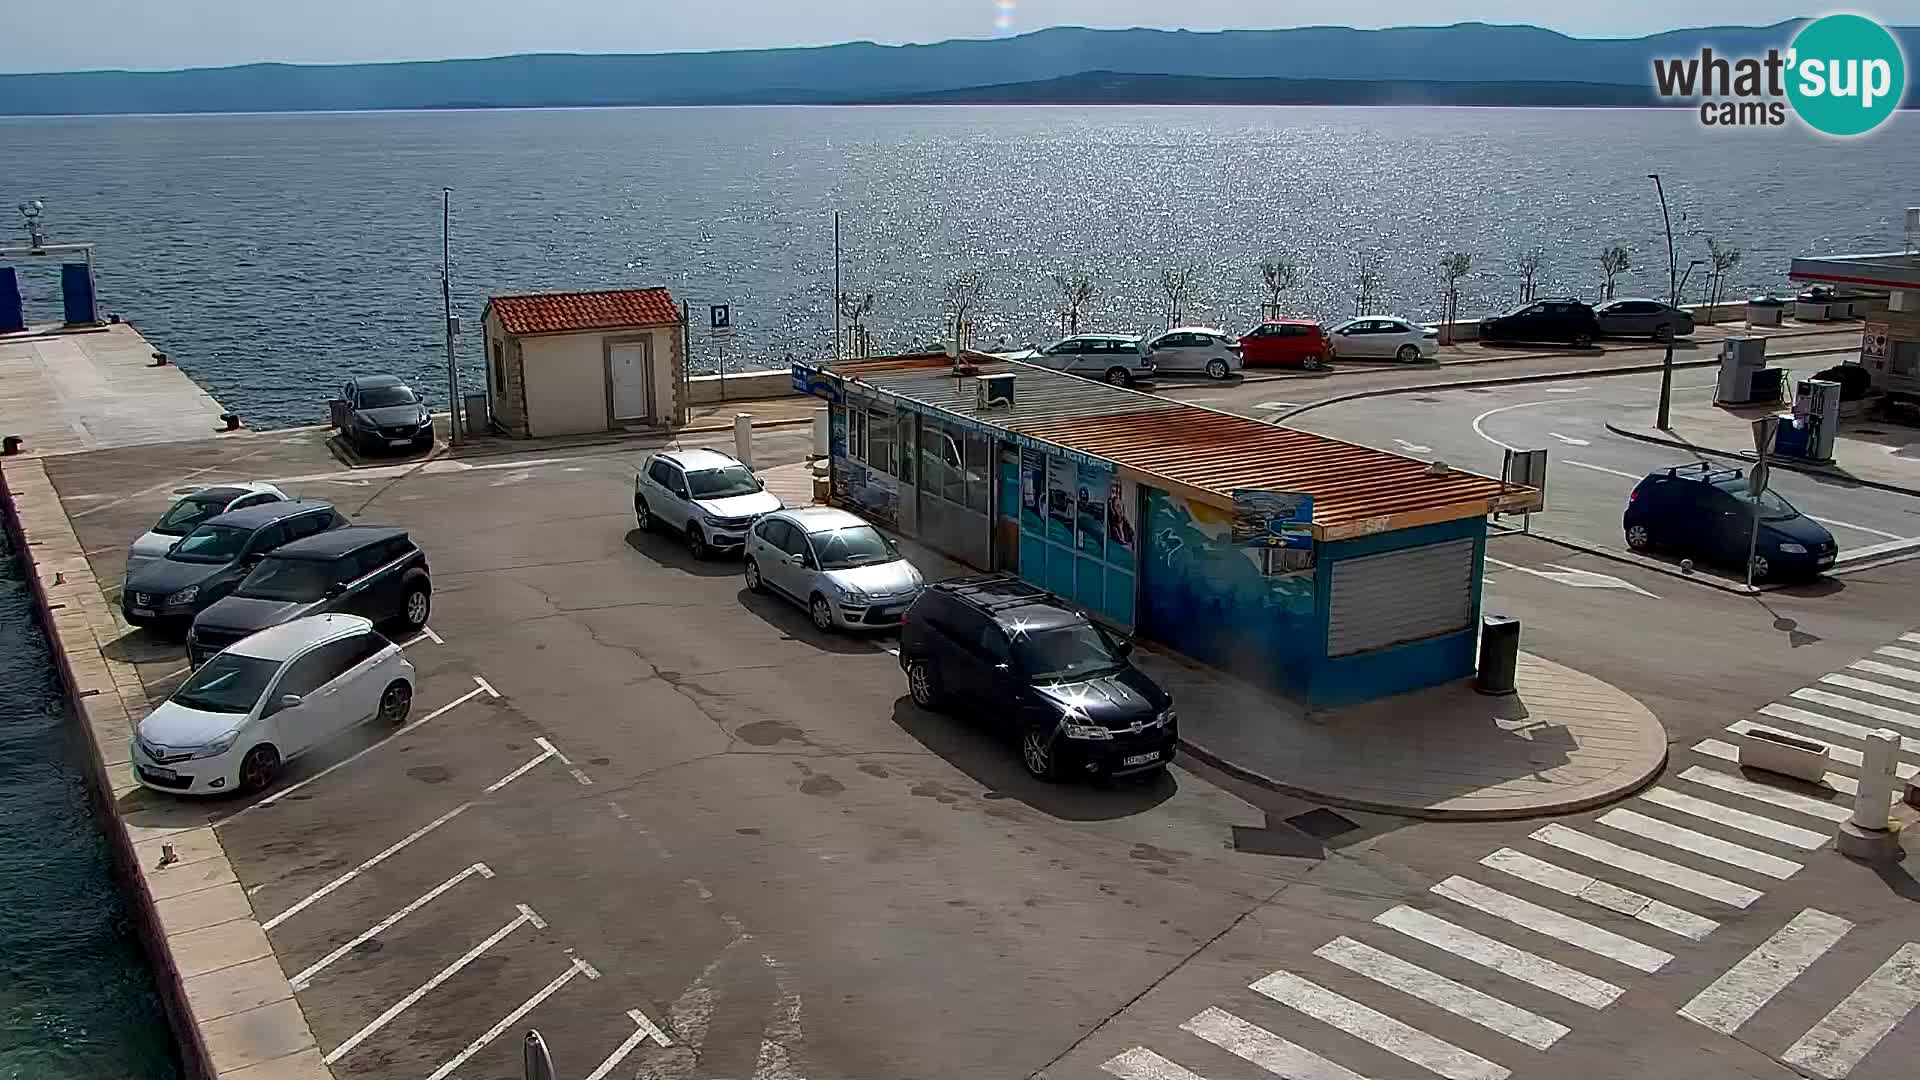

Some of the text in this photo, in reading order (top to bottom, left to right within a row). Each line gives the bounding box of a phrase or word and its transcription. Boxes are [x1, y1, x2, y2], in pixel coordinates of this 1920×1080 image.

[715, 308, 725, 325] P
[1031, 439, 1061, 456] STATION
[1062, 448, 1087, 465] TICKET
[1087, 456, 1113, 473] OFFICE
